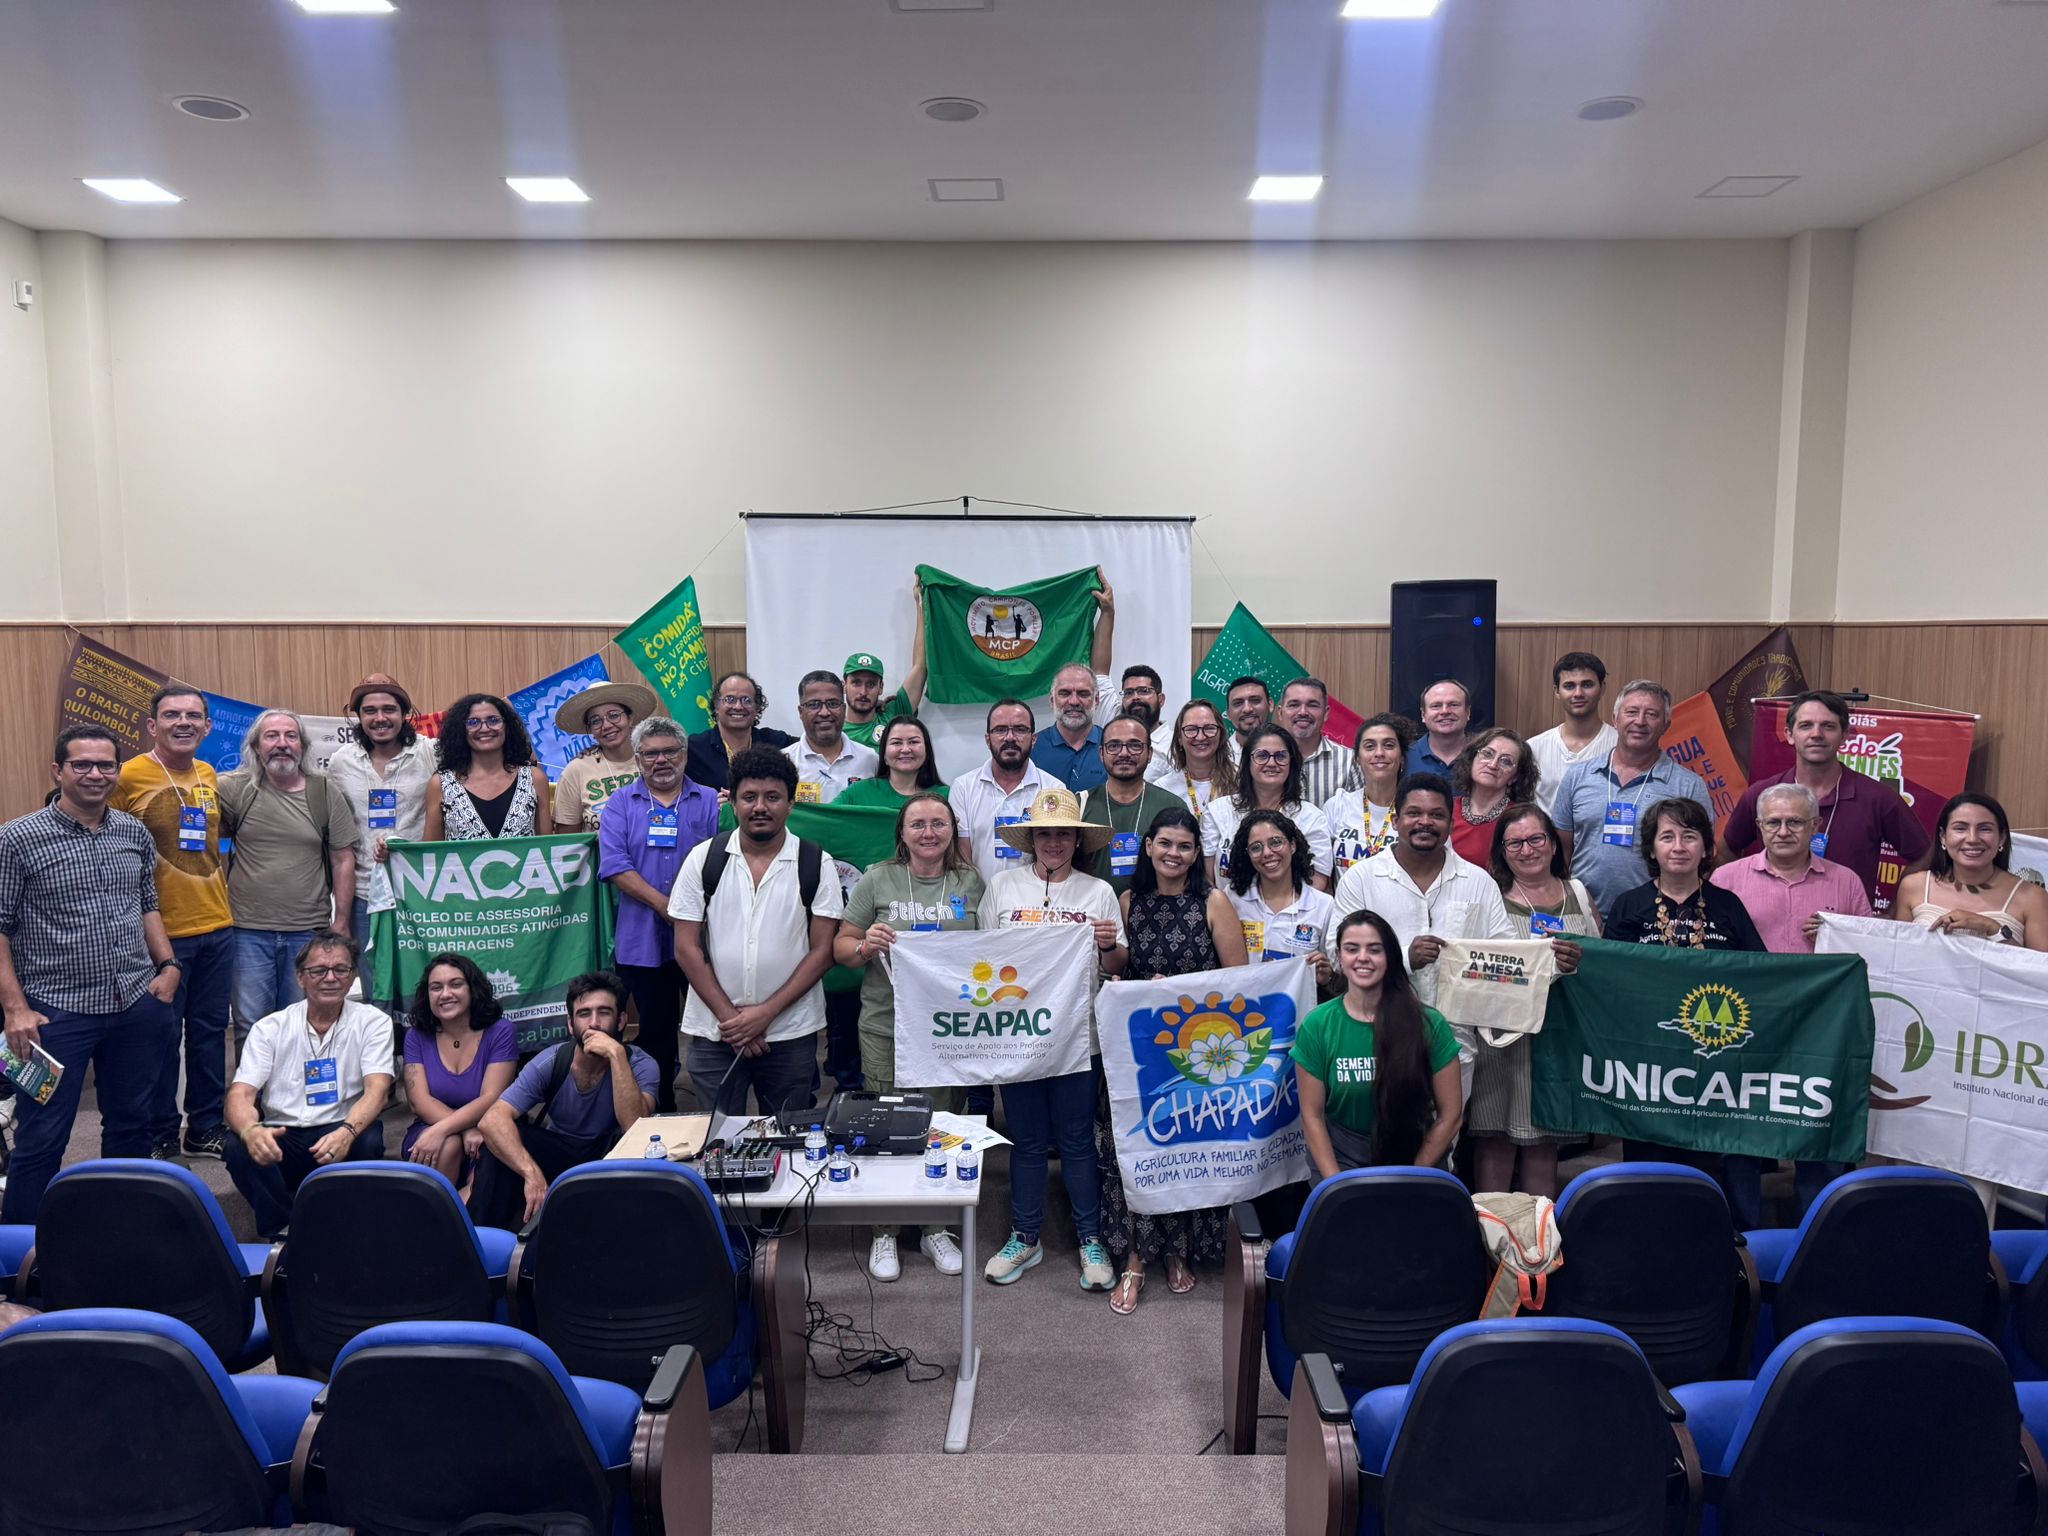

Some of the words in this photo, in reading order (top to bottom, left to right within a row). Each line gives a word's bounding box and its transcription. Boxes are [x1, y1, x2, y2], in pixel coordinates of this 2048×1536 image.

[645, 607, 696, 659] COMIDA
[989, 640, 1020, 650] MCP
[990, 650, 1016, 658] BRASIL
[654, 658, 668, 672] DE
[660, 665, 677, 688] NO
[1197, 669, 1231, 696] AGRO
[670, 688, 677, 698] E
[75, 687, 87, 698] O
[88, 691, 129, 719] BRASIL
[131, 711, 140, 724] É
[63, 699, 140, 741] QUILOMBOLA
[1849, 713, 1878, 727] oiás
[1666, 736, 1705, 765] GUA
[1339, 829, 1359, 841] DA
[1336, 839, 1346, 857] À
[389, 844, 592, 902] NACAB
[396, 909, 450, 923] NÚCLEO
[454, 912, 473, 922] DE
[476, 904, 562, 922] ASSESSORIA
[888, 900, 954, 922] Stitch
[397, 923, 415, 936] ÀS
[417, 924, 518, 938] COMUNIDADES
[521, 912, 589, 933] ATINGIDAS
[398, 939, 425, 950] POR
[428, 938, 515, 952] BARRAGENS
[1469, 958, 1478, 971] À
[1482, 962, 1524, 977] MESA
[1470, 951, 1485, 961] DA
[1488, 953, 1525, 966] TERRA
[502, 1005, 567, 1023] INDEPENDENT
[931, 1008, 1052, 1037] SEAPAC
[931, 1042, 964, 1052] Serviço
[966, 1042, 974, 1050] de
[977, 1041, 1001, 1052] Apoio
[1019, 1041, 1053, 1052] Projetos
[938, 1051, 989, 1060] Alternativos
[990, 1051, 1047, 1061] Comunitários
[1336, 1056, 1377, 1070] SEMENT
[1954, 1030, 2048, 1090] IDR
[1337, 1070, 1350, 1082] DA
[1582, 1054, 1833, 1118] UNICAFES
[1953, 1080, 1990, 1096] Instituto
[1992, 1088, 2035, 1104] Nacional
[1147, 1075, 1296, 1143] CHAPADA
[1581, 1092, 1599, 1101] União
[1641, 1105, 1680, 1115] Cooperativas
[1691, 1109, 1729, 1119] Agricultura
[1730, 1112, 1758, 1121] Familiar
[1765, 1115, 1799, 1127] Economia
[1800, 1119, 1830, 1128] Solidária
[1134, 1151, 1207, 1173] AGRICULTURA
[1211, 1148, 1258, 1163] FAMILIAR
[1260, 1148, 1267, 1158] E
[1135, 1172, 1155, 1188] POR
[1158, 1168, 1181, 1184] UMA
[1183, 1166, 1209, 1179] VIDA
[1213, 1164, 1254, 1178] MELHOR
[1257, 1159, 1269, 1173] NO
